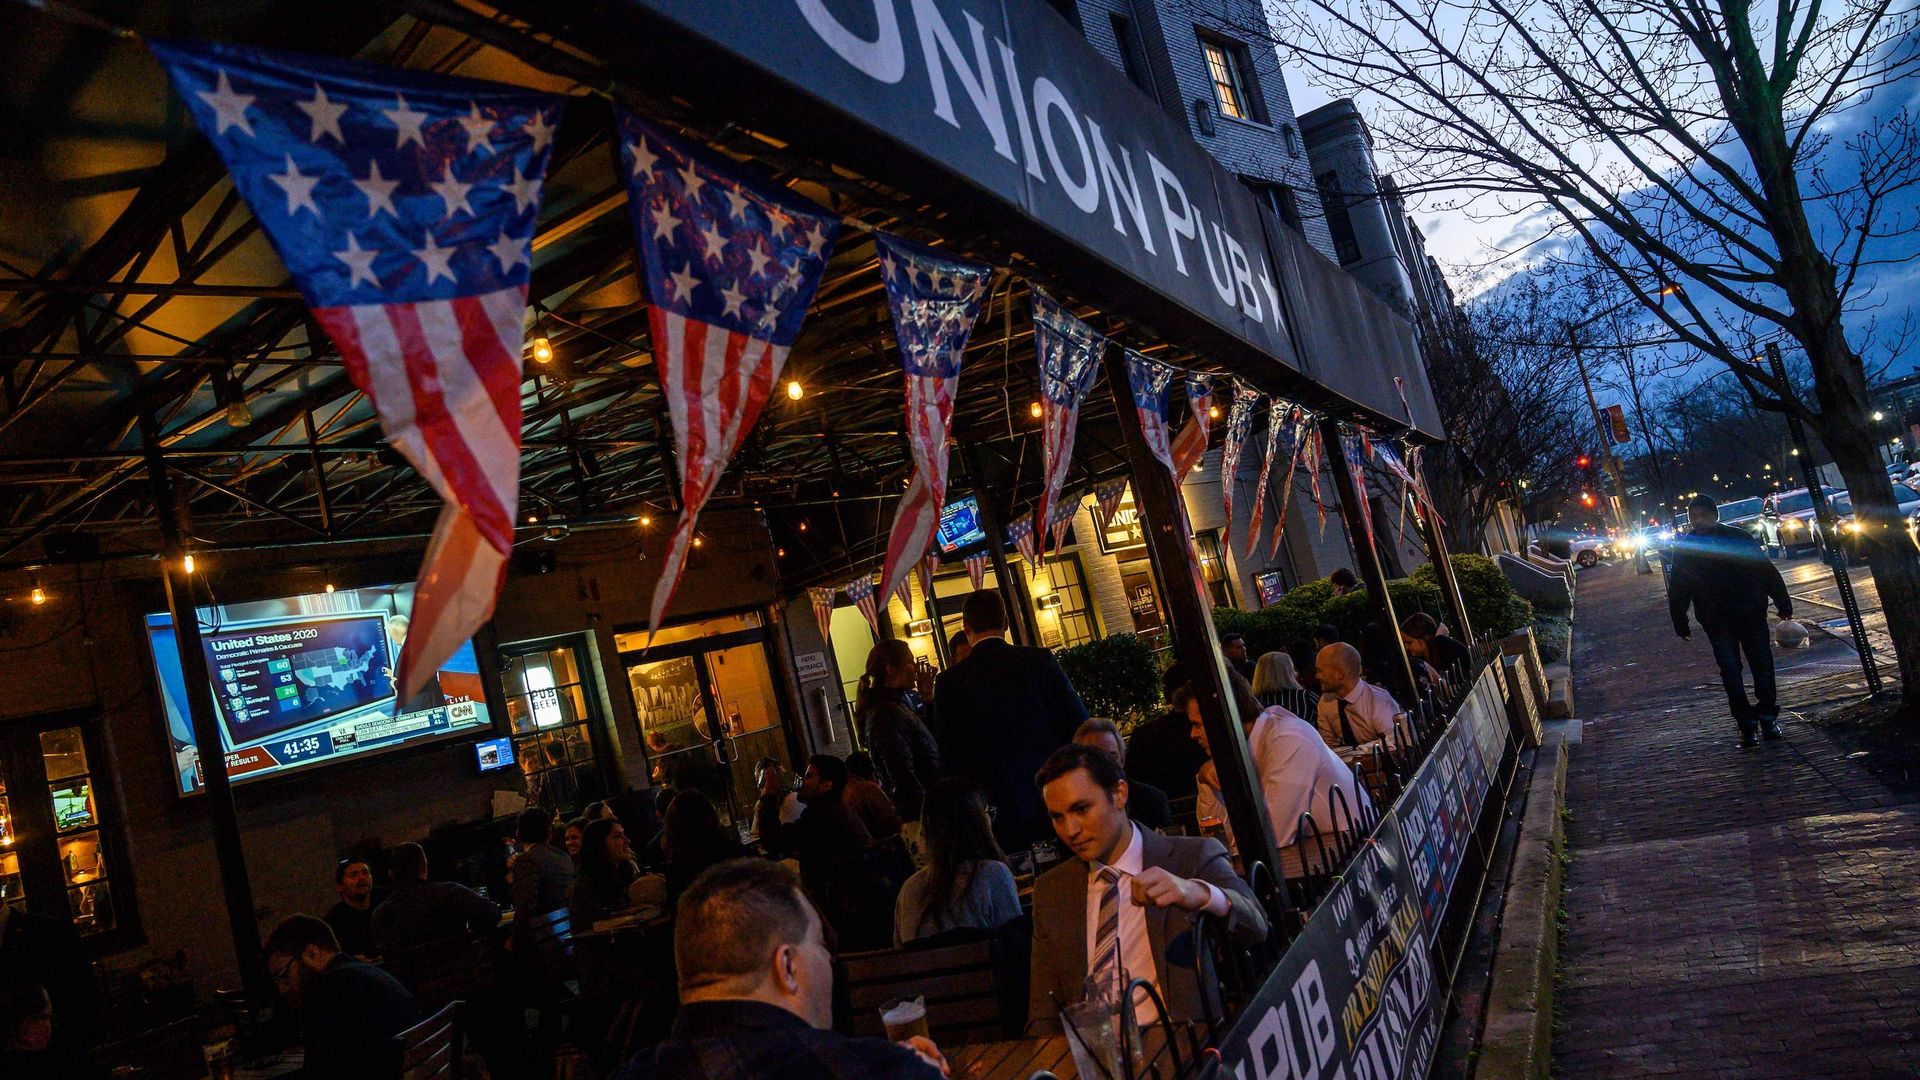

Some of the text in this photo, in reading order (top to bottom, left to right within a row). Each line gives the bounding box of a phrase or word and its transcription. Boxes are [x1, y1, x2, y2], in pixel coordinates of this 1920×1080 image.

[1147, 150, 1263, 324] PUB
[211, 628, 318, 652] United States 2020
[215, 650, 249, 660] Democratic
[276, 661, 288, 670] 60
[280, 674, 292, 683] 53
[450, 695, 470, 704] LIVE
[531, 687, 555, 699] PUB
[451, 704, 474, 718] CNN
[533, 698, 557, 710] BEER
[283, 737, 320, 755] 41:35
[231, 755, 258, 767] RESULTS
[1421, 773, 1441, 822] UNION
[1401, 801, 1426, 859] UNION
[1431, 815, 1445, 856] PUB
[1412, 850, 1430, 897] PUB
[1341, 893, 1418, 1054] PRESIDENTIAL
[1246, 958, 1336, 1080] PUB
